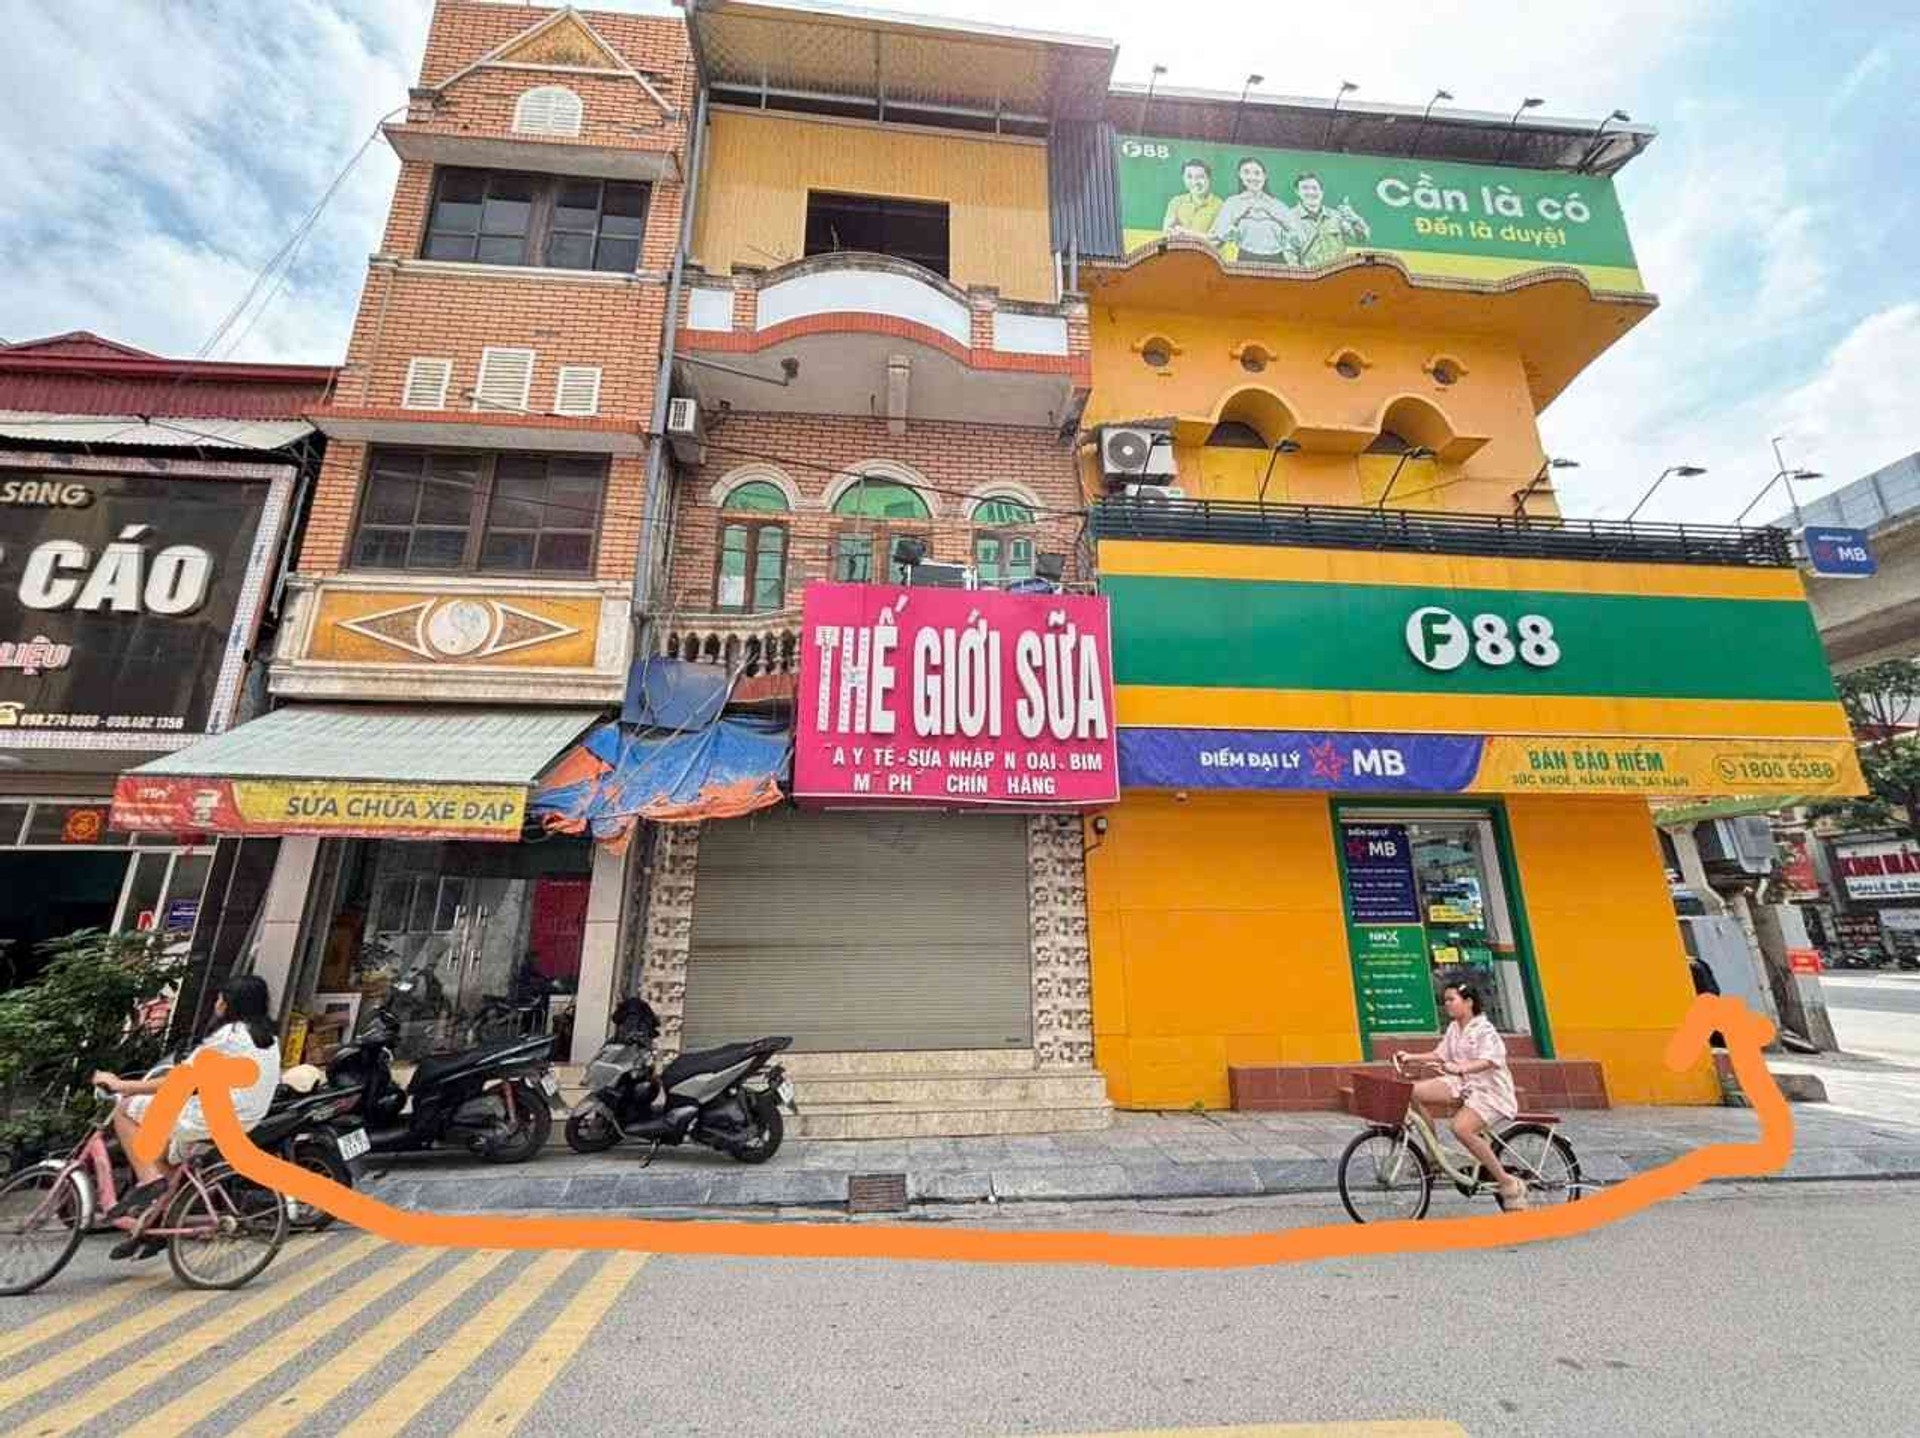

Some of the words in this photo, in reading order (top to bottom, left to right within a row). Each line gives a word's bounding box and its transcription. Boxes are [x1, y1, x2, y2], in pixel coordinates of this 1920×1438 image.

[1376, 172, 1469, 213] Cần
[1480, 186, 1525, 219] là
[1536, 192, 1591, 223] có
[1414, 217, 1463, 238] Đến
[1469, 220, 1494, 240] là
[0, 481, 86, 507] SANG
[1837, 546, 1868, 562] MB
[18, 523, 213, 615] CÁO
[1406, 606, 1562, 672] F88
[815, 594, 909, 735] THẾ
[912, 608, 1002, 738] GIỚI
[1015, 609, 1109, 739] SỮA
[1200, 746, 1245, 768] ĐIỂM
[1246, 752, 1279, 772] ĐẠI
[1352, 749, 1407, 776] MB
[1528, 745, 1567, 770] BÁN
[1572, 744, 1610, 771] BẢO
[1615, 744, 1664, 772] HIỂM
[1739, 761, 1783, 778] 1800
[285, 790, 339, 817] SỬA
[346, 793, 418, 819] CHỮA
[422, 800, 459, 820] XE
[462, 801, 515, 826] ĐẠP
[1369, 841, 1398, 857] MB
